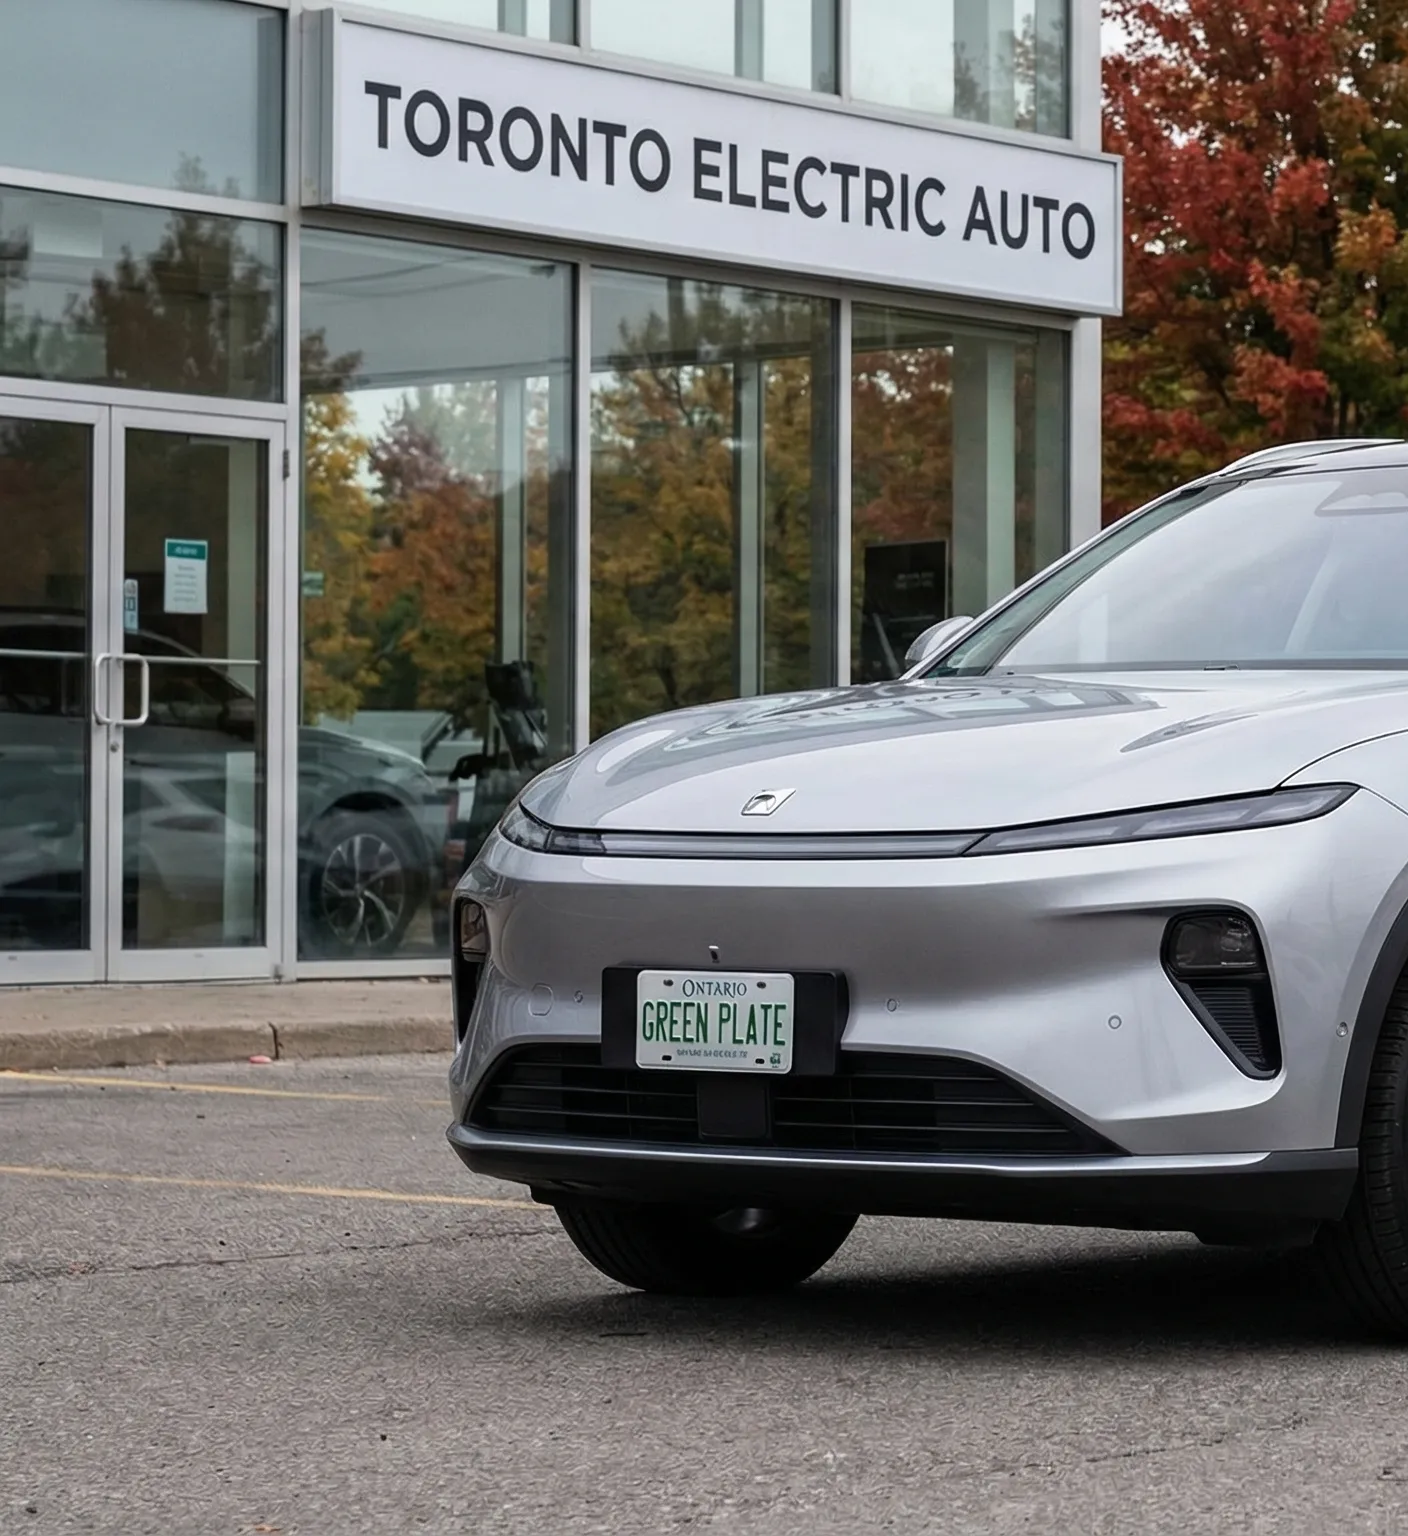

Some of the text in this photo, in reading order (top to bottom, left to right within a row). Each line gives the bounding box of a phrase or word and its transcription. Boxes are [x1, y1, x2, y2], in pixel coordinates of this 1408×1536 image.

[364, 80, 1097, 260] TORONTO ELECTRIC AUTO
[682, 979, 748, 998] ONTARIO
[642, 1001, 787, 1046] GREEN PLATE
